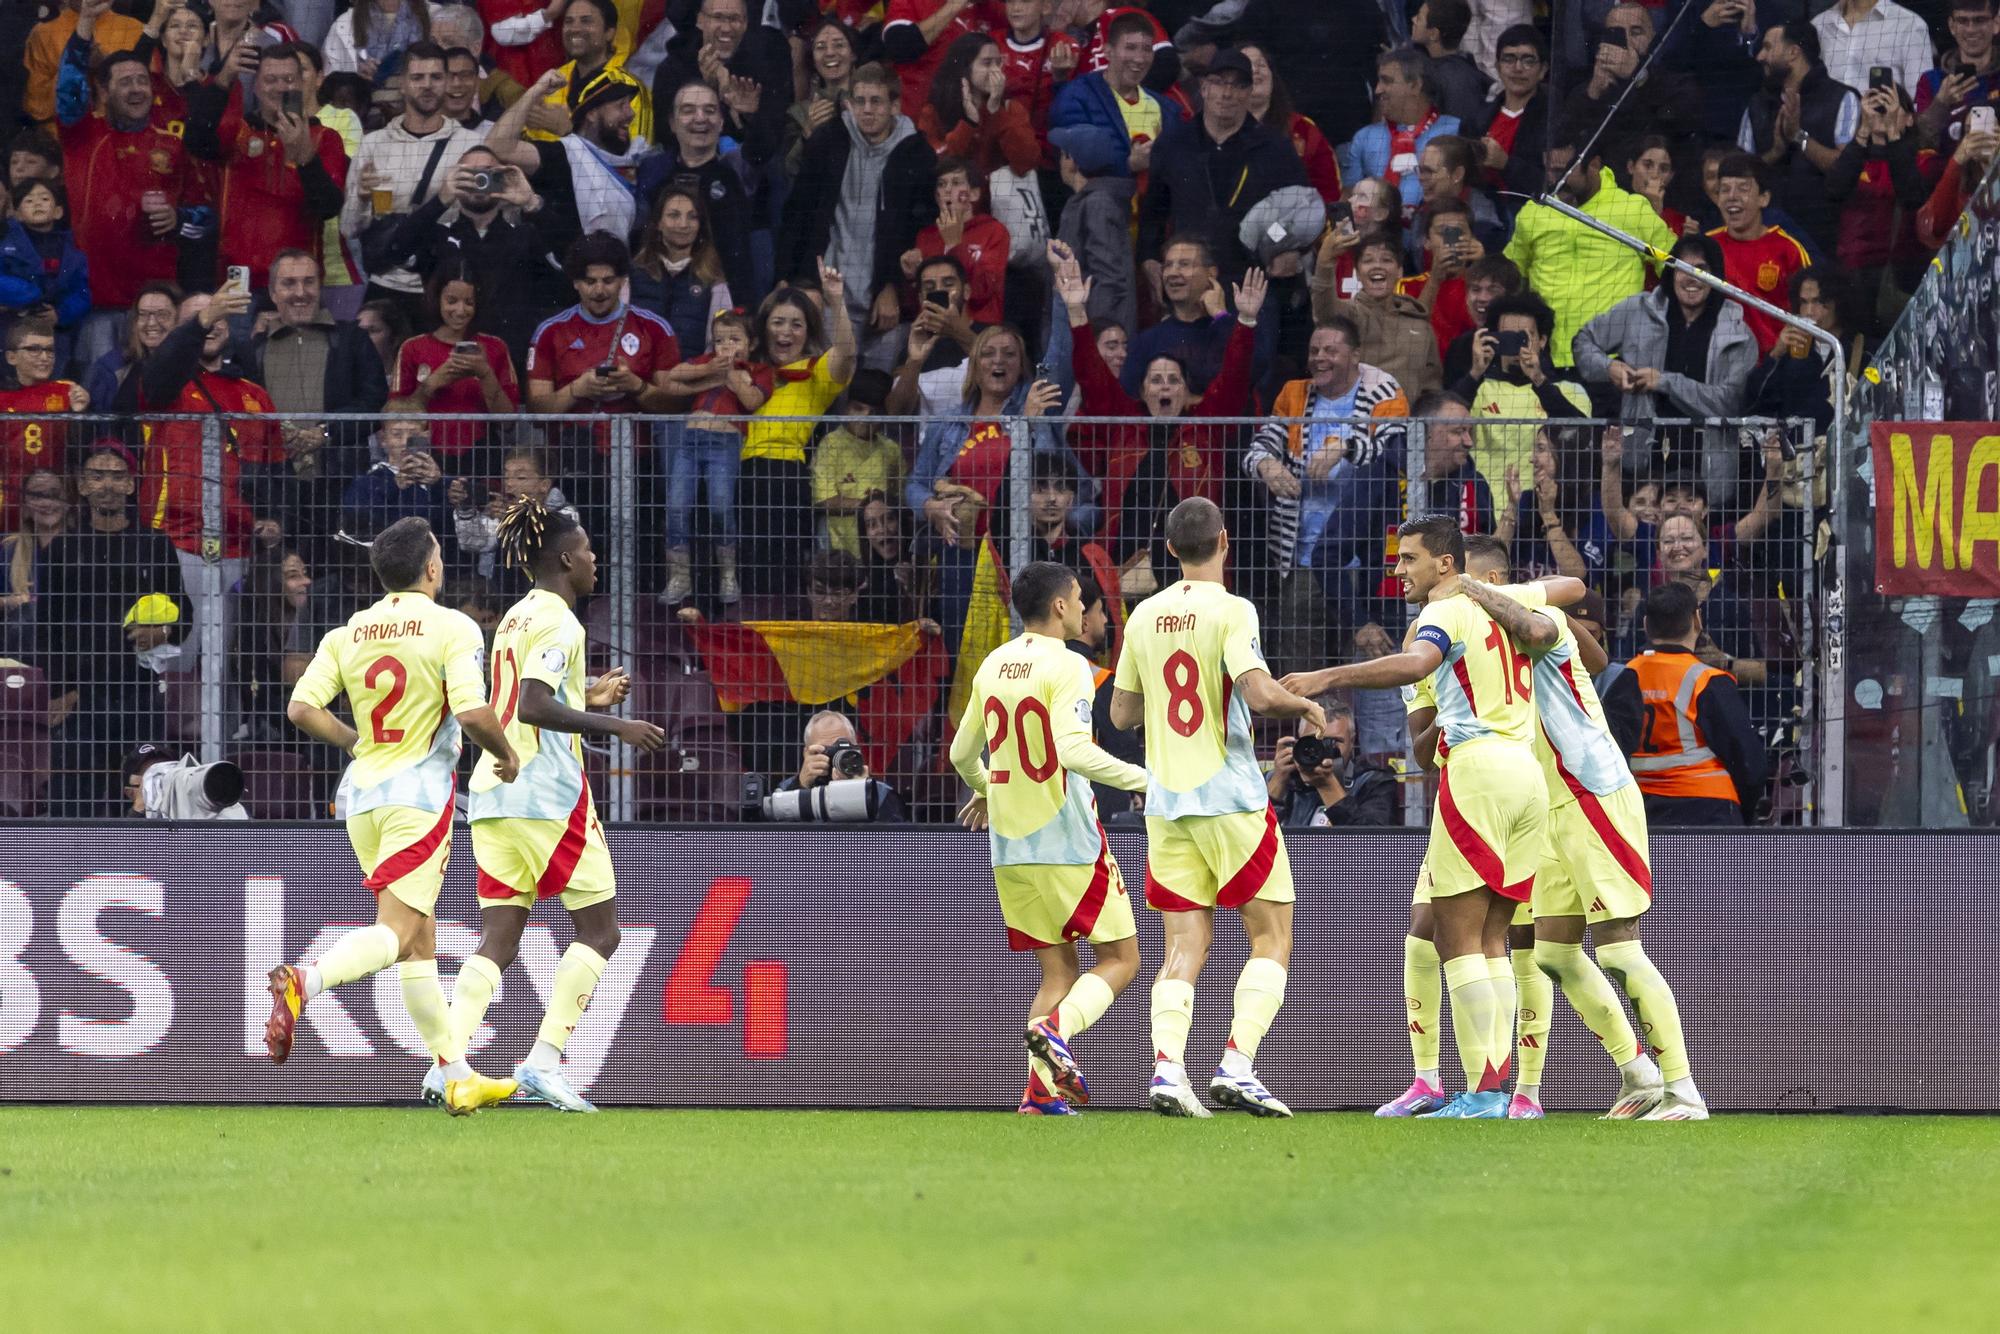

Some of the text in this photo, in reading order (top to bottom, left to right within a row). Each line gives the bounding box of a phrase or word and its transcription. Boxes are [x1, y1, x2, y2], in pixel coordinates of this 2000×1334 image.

[24, 423, 42, 454] 8
[1890, 433, 2000, 571] MA
[353, 620, 424, 643] CARVAJAL
[998, 663, 1033, 679] PEDRI
[1485, 620, 1533, 705] 16
[365, 655, 407, 744] 2
[1163, 649, 1204, 737] 8
[984, 695, 1059, 783] 20
